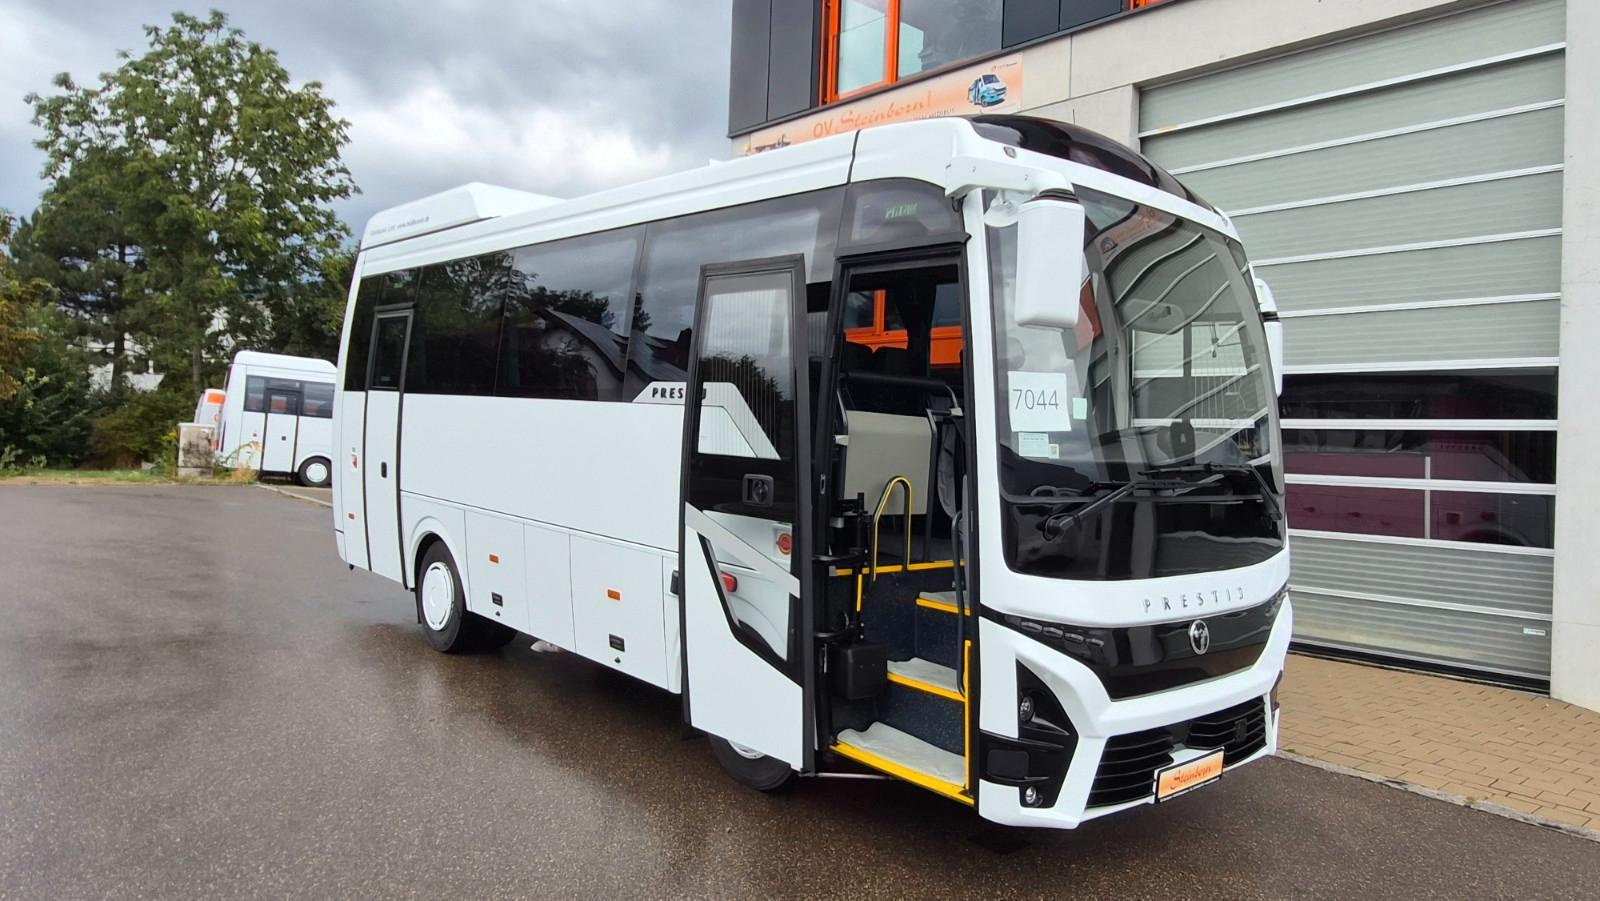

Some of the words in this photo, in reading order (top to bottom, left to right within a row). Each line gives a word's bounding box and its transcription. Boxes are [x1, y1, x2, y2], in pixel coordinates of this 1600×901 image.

[652, 387, 707, 399] PRESJ
[1013, 389, 1059, 409] 7044
[1143, 586, 1244, 612] PRESTIJ
